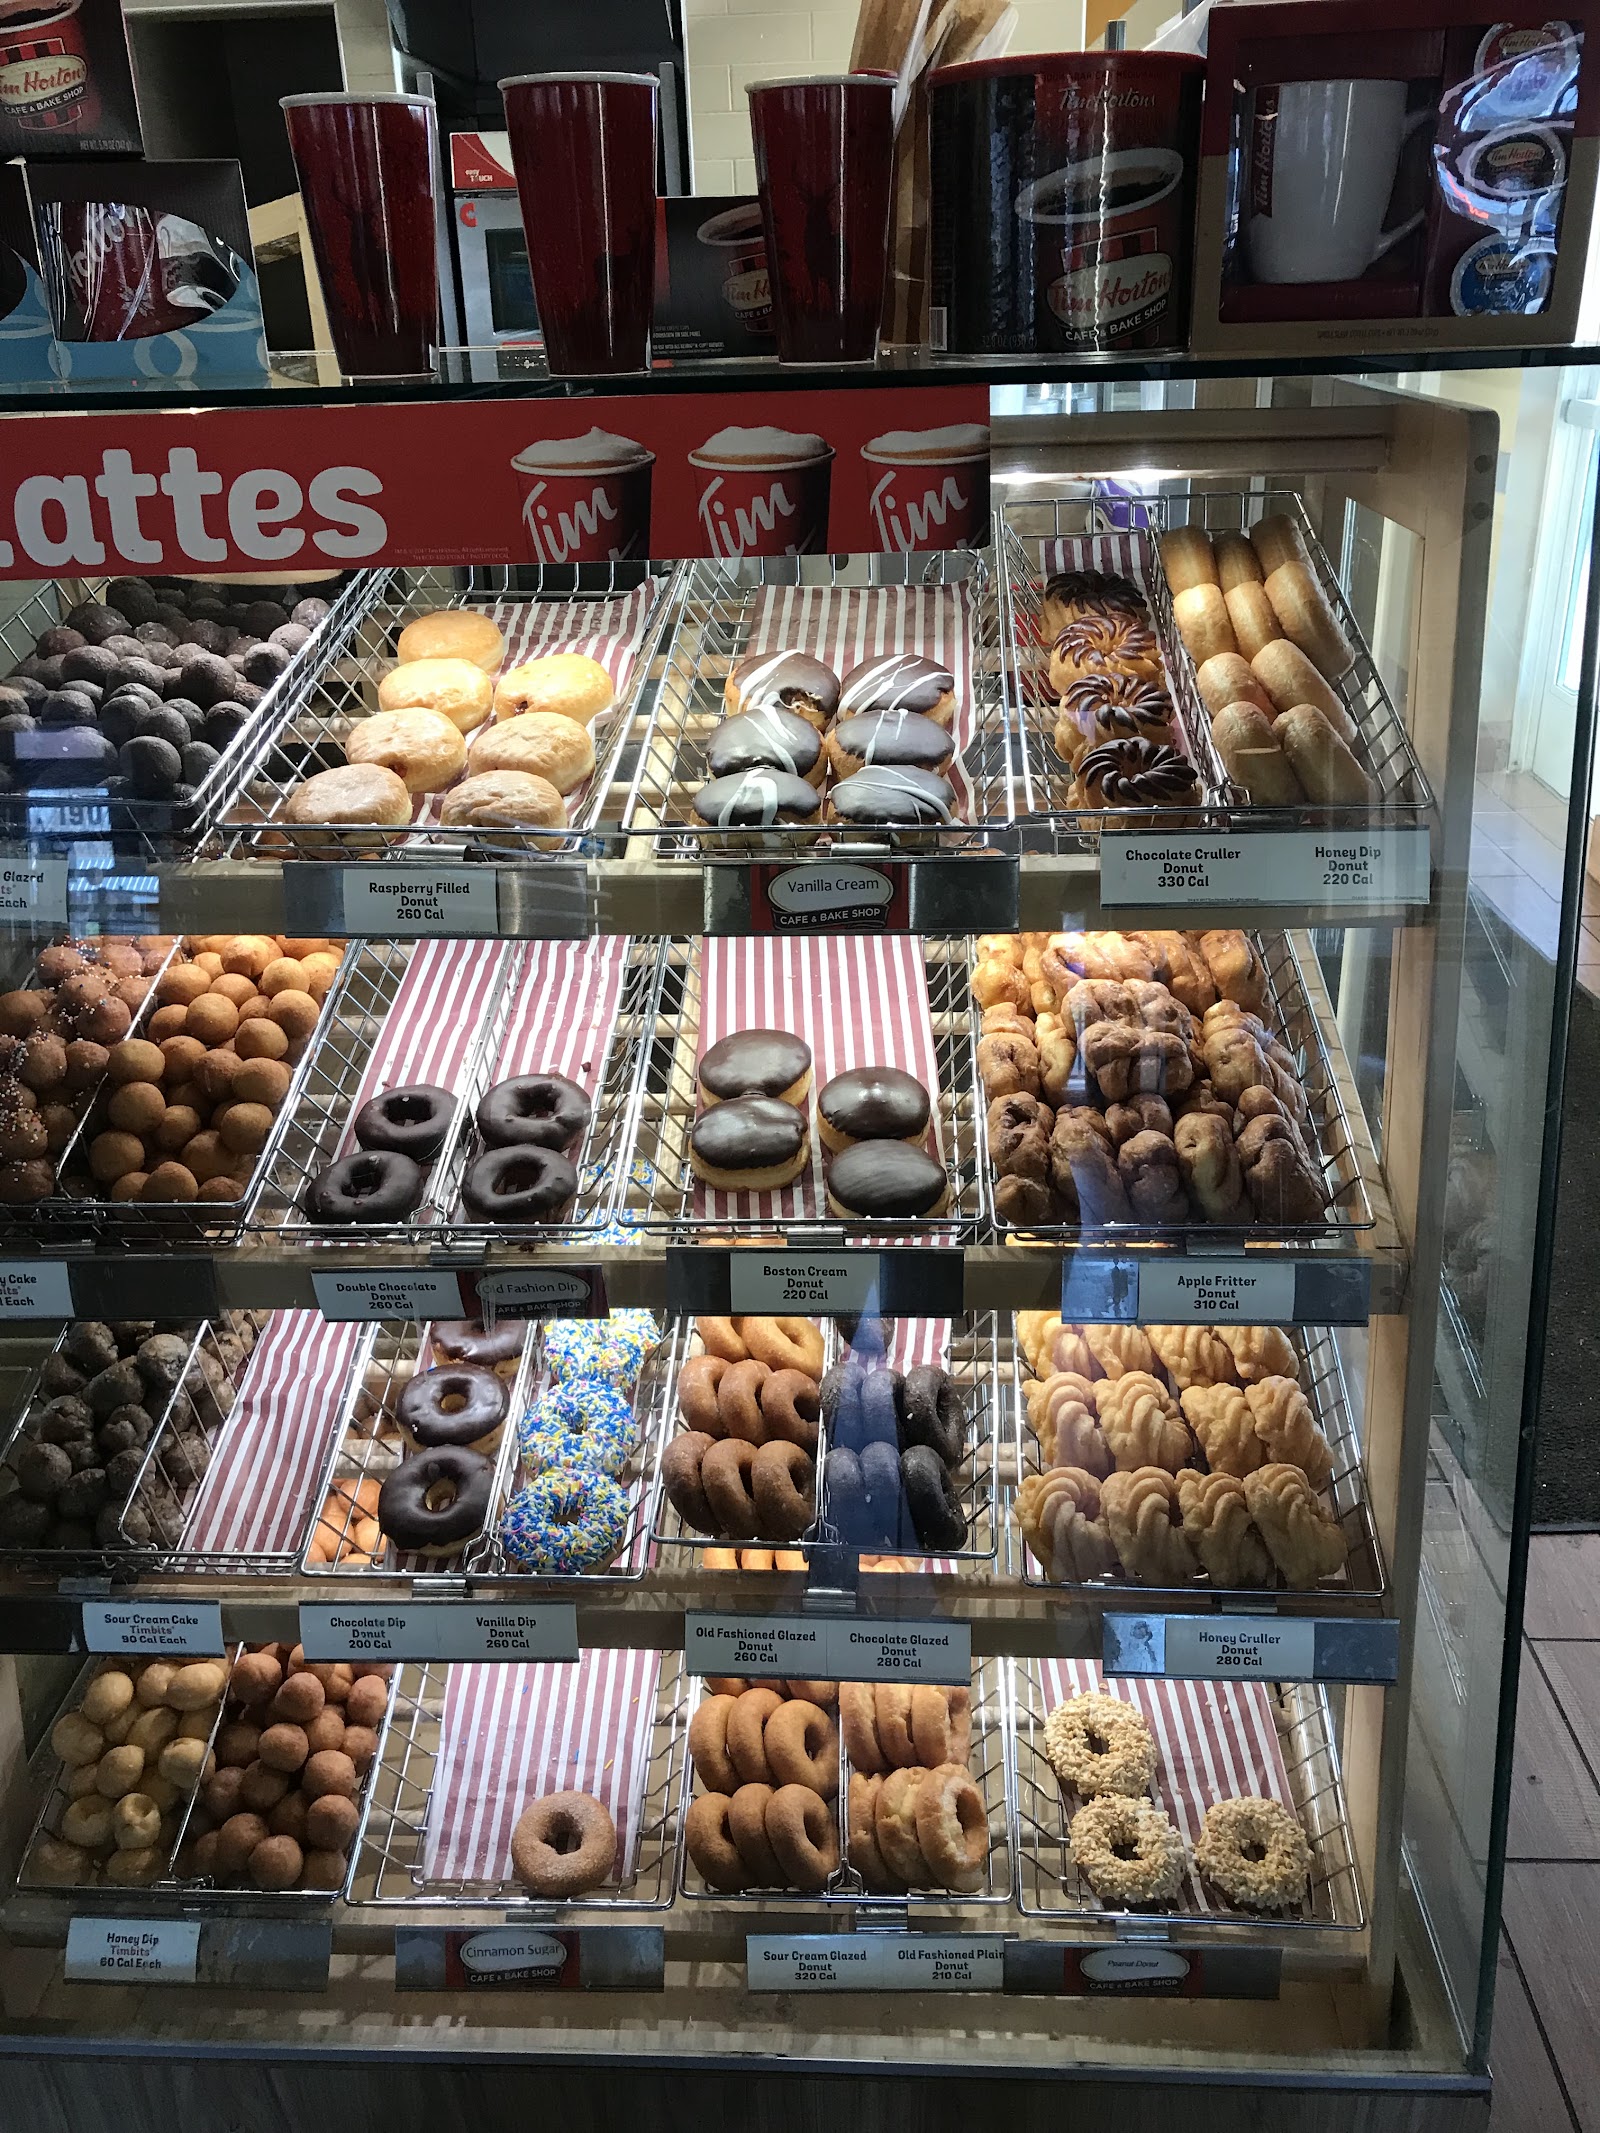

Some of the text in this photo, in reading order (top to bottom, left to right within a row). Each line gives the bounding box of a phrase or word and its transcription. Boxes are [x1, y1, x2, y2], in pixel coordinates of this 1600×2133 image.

[4, 106, 28, 114] CAFE
[36, 98, 62, 111] BAKE
[63, 86, 84, 101] SHOP
[1065, 329, 1097, 342] CAFE
[1110, 314, 1142, 335] BAKE
[1144, 298, 1168, 320] SHOP
[0, 446, 389, 568] attes
[869, 470, 968, 553] Tim
[522, 481, 618, 563] Tim
[699, 476, 796, 557] Tim
[1125, 848, 1241, 861] Chocolate Cruller
[1315, 846, 1382, 859] Honey Dip
[1163, 862, 1204, 874] Donut
[1328, 860, 1369, 872] Donut
[1157, 874, 1209, 887] 330 Cal
[1323, 873, 1374, 885] 220 Cal
[369, 882, 470, 896] Raspberry Filled
[787, 877, 879, 893] Vanilla Cream
[401, 895, 438, 906] Donut
[396, 908, 445, 919] 260 Cal
[780, 907, 881, 926] CAFE & BAKE SHOP
[763, 1265, 848, 1277] Boston Cream
[9, 1274, 37, 1284] Cake
[787, 1278, 824, 1288] Donut
[1177, 1275, 1257, 1288] Apple Fritter
[336, 1282, 437, 1293] Double Chocolate
[508, 1282, 555, 1294] Fashion
[558, 1282, 578, 1294] Dip
[1198, 1288, 1236, 1298] Donut
[371, 1292, 407, 1301] Donut
[782, 1289, 829, 1300] 220 Cal
[5, 1297, 35, 1306] Each
[368, 1301, 414, 1310] 260 Cal
[527, 1302, 550, 1313] BAKE
[555, 1301, 582, 1311] SHOP
[1193, 1299, 1239, 1310] 310 Cal
[104, 1613, 199, 1625] Sour Cream Cake
[330, 1617, 406, 1629] Chocolate Dip
[476, 1616, 537, 1628] Vanilla Dip
[352, 1629, 386, 1639] Donut
[490, 1628, 524, 1638] Donut
[696, 1627, 816, 1642] Old Fashioned Glazed
[1199, 1631, 1281, 1645] Honey Cruller
[121, 1635, 187, 1644] 90 Cal Each
[348, 1639, 392, 1649] 200 Cal
[486, 1638, 530, 1648] 260 Cal
[850, 1633, 949, 1646] Chocolate Glazed
[738, 1641, 773, 1651] Donut
[881, 1646, 917, 1657] Donut
[1221, 1645, 1258, 1655] Donut
[734, 1651, 778, 1663] 260 Cal
[877, 1657, 922, 1668] 280 Cal
[1216, 1655, 1263, 1666] 280 Cal
[106, 1932, 160, 1947] Honey Dip
[466, 1944, 560, 1958] Cinnamon Sugar
[763, 1950, 867, 1961] Sour Cream Glazed
[898, 1950, 916, 1960] Old
[918, 1949, 975, 1960] Fashioned
[116, 1957, 134, 1968] Cal
[799, 1962, 832, 1971] Donut
[935, 1961, 969, 1970] Donut
[1107, 1960, 1134, 1968] Peanut
[470, 1974, 494, 1983] CAFE
[504, 1971, 529, 1981] BAKE
[531, 1968, 556, 1979] SHOP
[794, 1972, 837, 1980] 320 Cal
[932, 1971, 972, 1980] 210 Cal
[1090, 1982, 1114, 1990] CAFE
[1124, 1980, 1150, 1989] BAKE
[1153, 1979, 1178, 1987] SHOP
